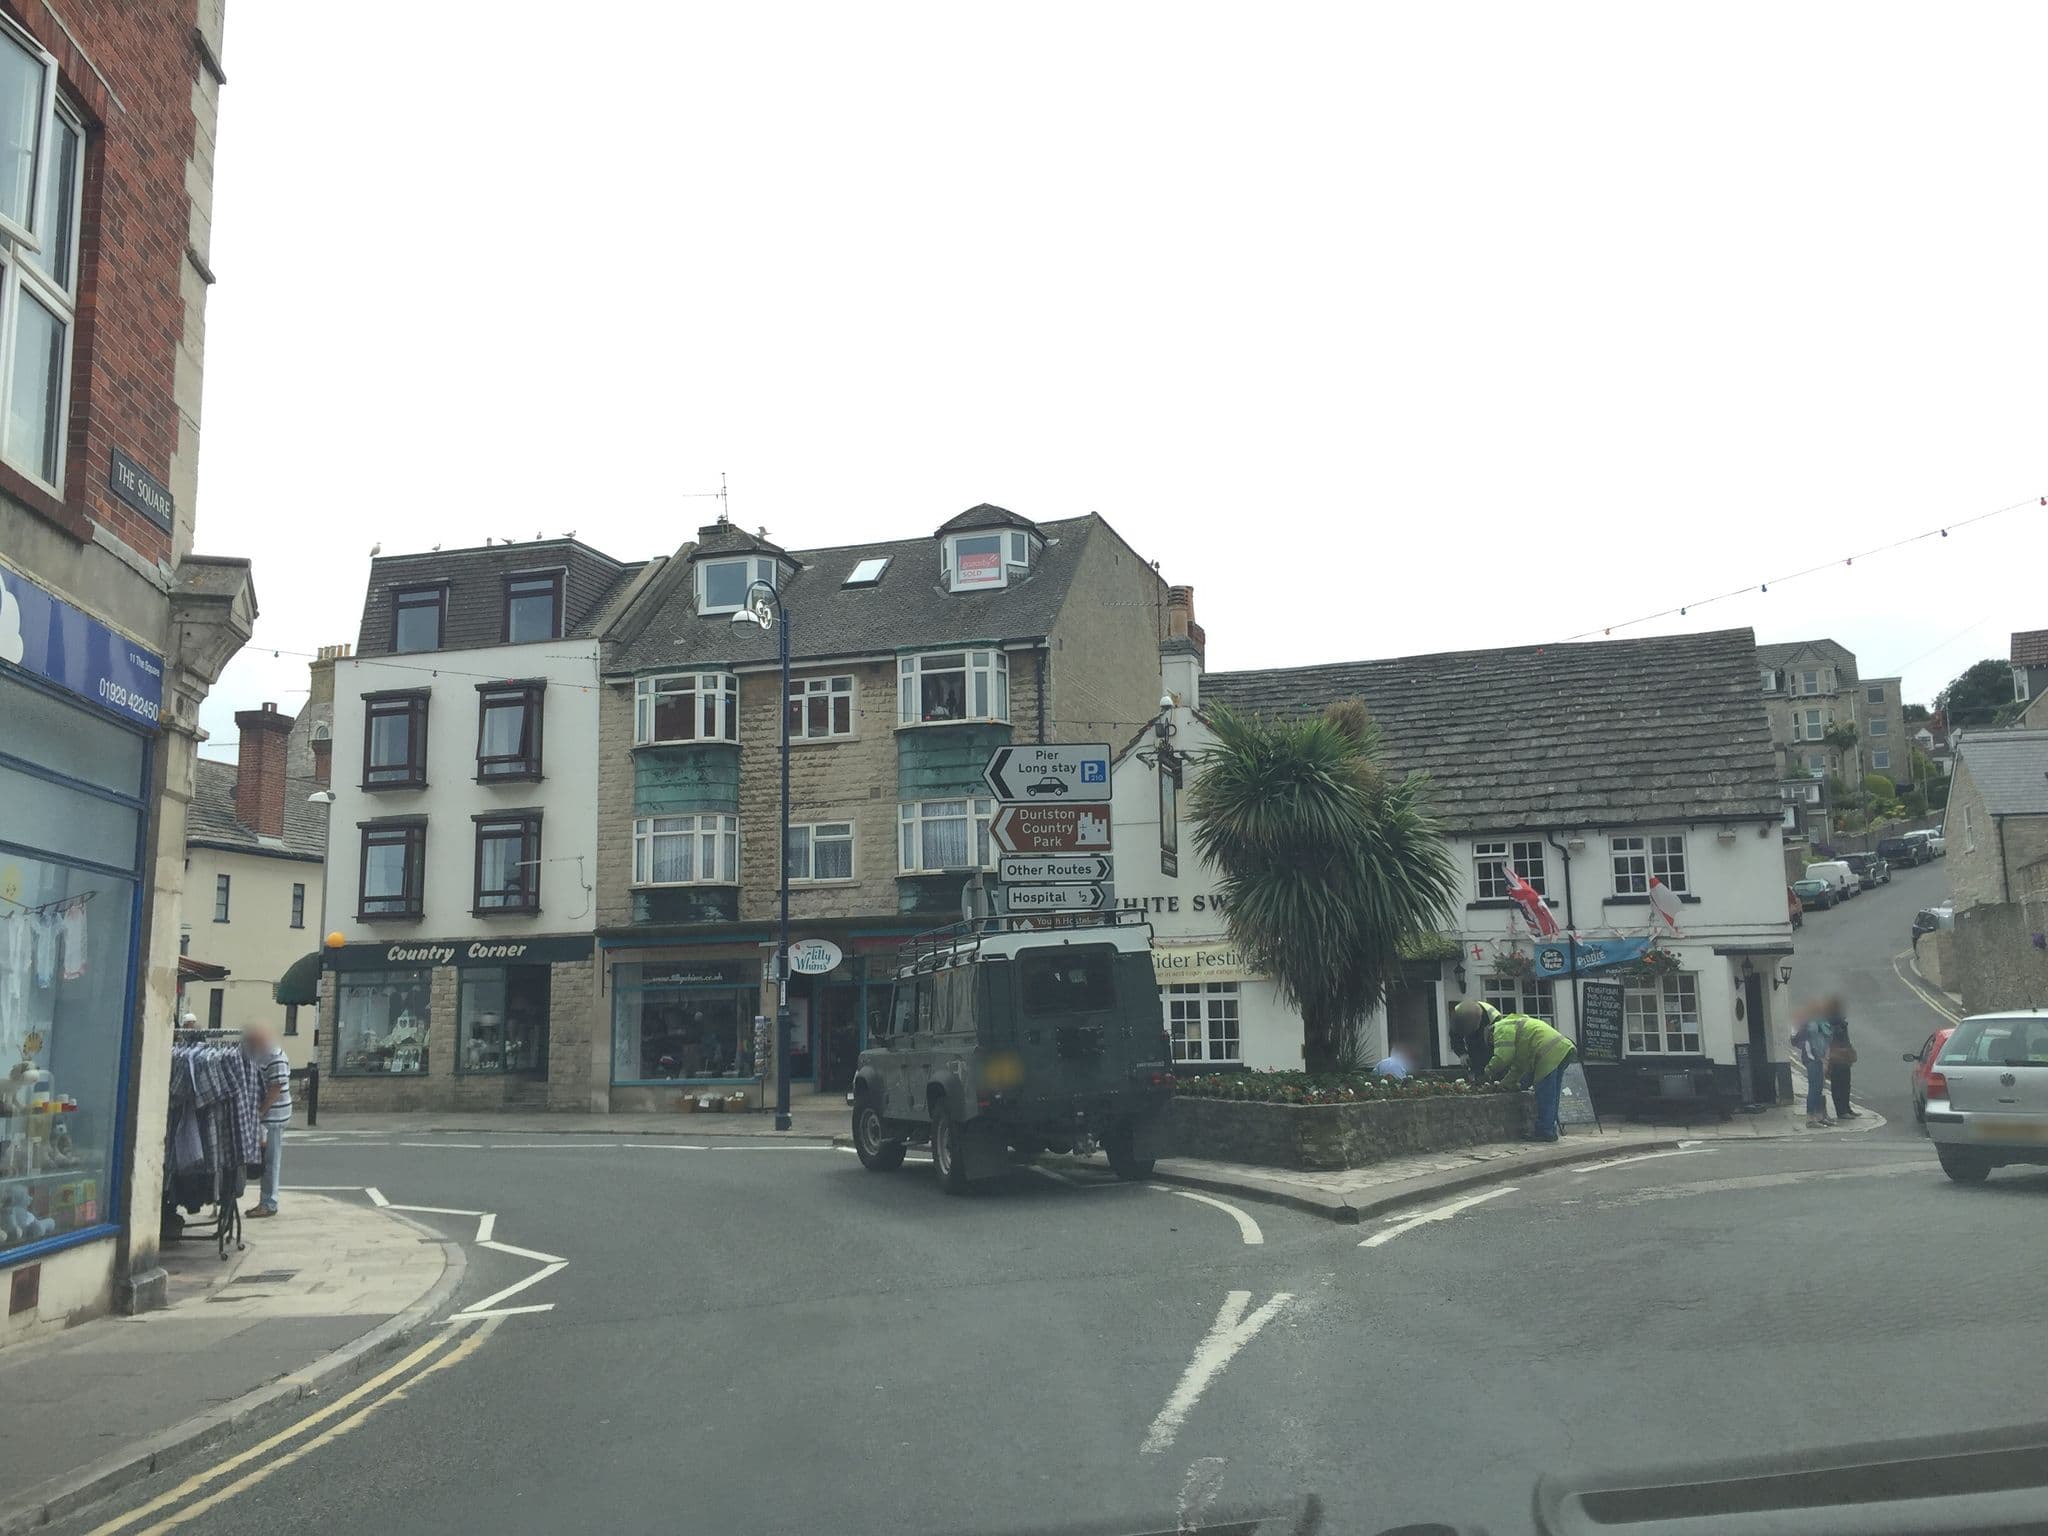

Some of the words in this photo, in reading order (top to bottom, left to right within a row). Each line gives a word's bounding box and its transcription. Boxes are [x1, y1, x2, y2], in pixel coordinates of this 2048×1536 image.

[118, 461, 135, 491] THE
[137, 479, 170, 519] SQUARE
[99, 677, 127, 706] 01929
[127, 693, 159, 722] 422450
[1036, 750, 1059, 760] Pier
[1018, 763, 1047, 774] Long
[1051, 763, 1077, 774] stay
[1020, 809, 1075, 820] Durlston
[1022, 822, 1073, 835] Country
[1033, 836, 1062, 847] Park
[1007, 864, 1043, 876] Other
[1047, 863, 1092, 875] Routes
[1013, 891, 1067, 904] Hospital
[1114, 895, 1180, 913] HITE
[1037, 917, 1060, 925] Youh
[387, 945, 455, 963] Country
[468, 942, 527, 958] Corner
[1196, 949, 1252, 967] Festiv
